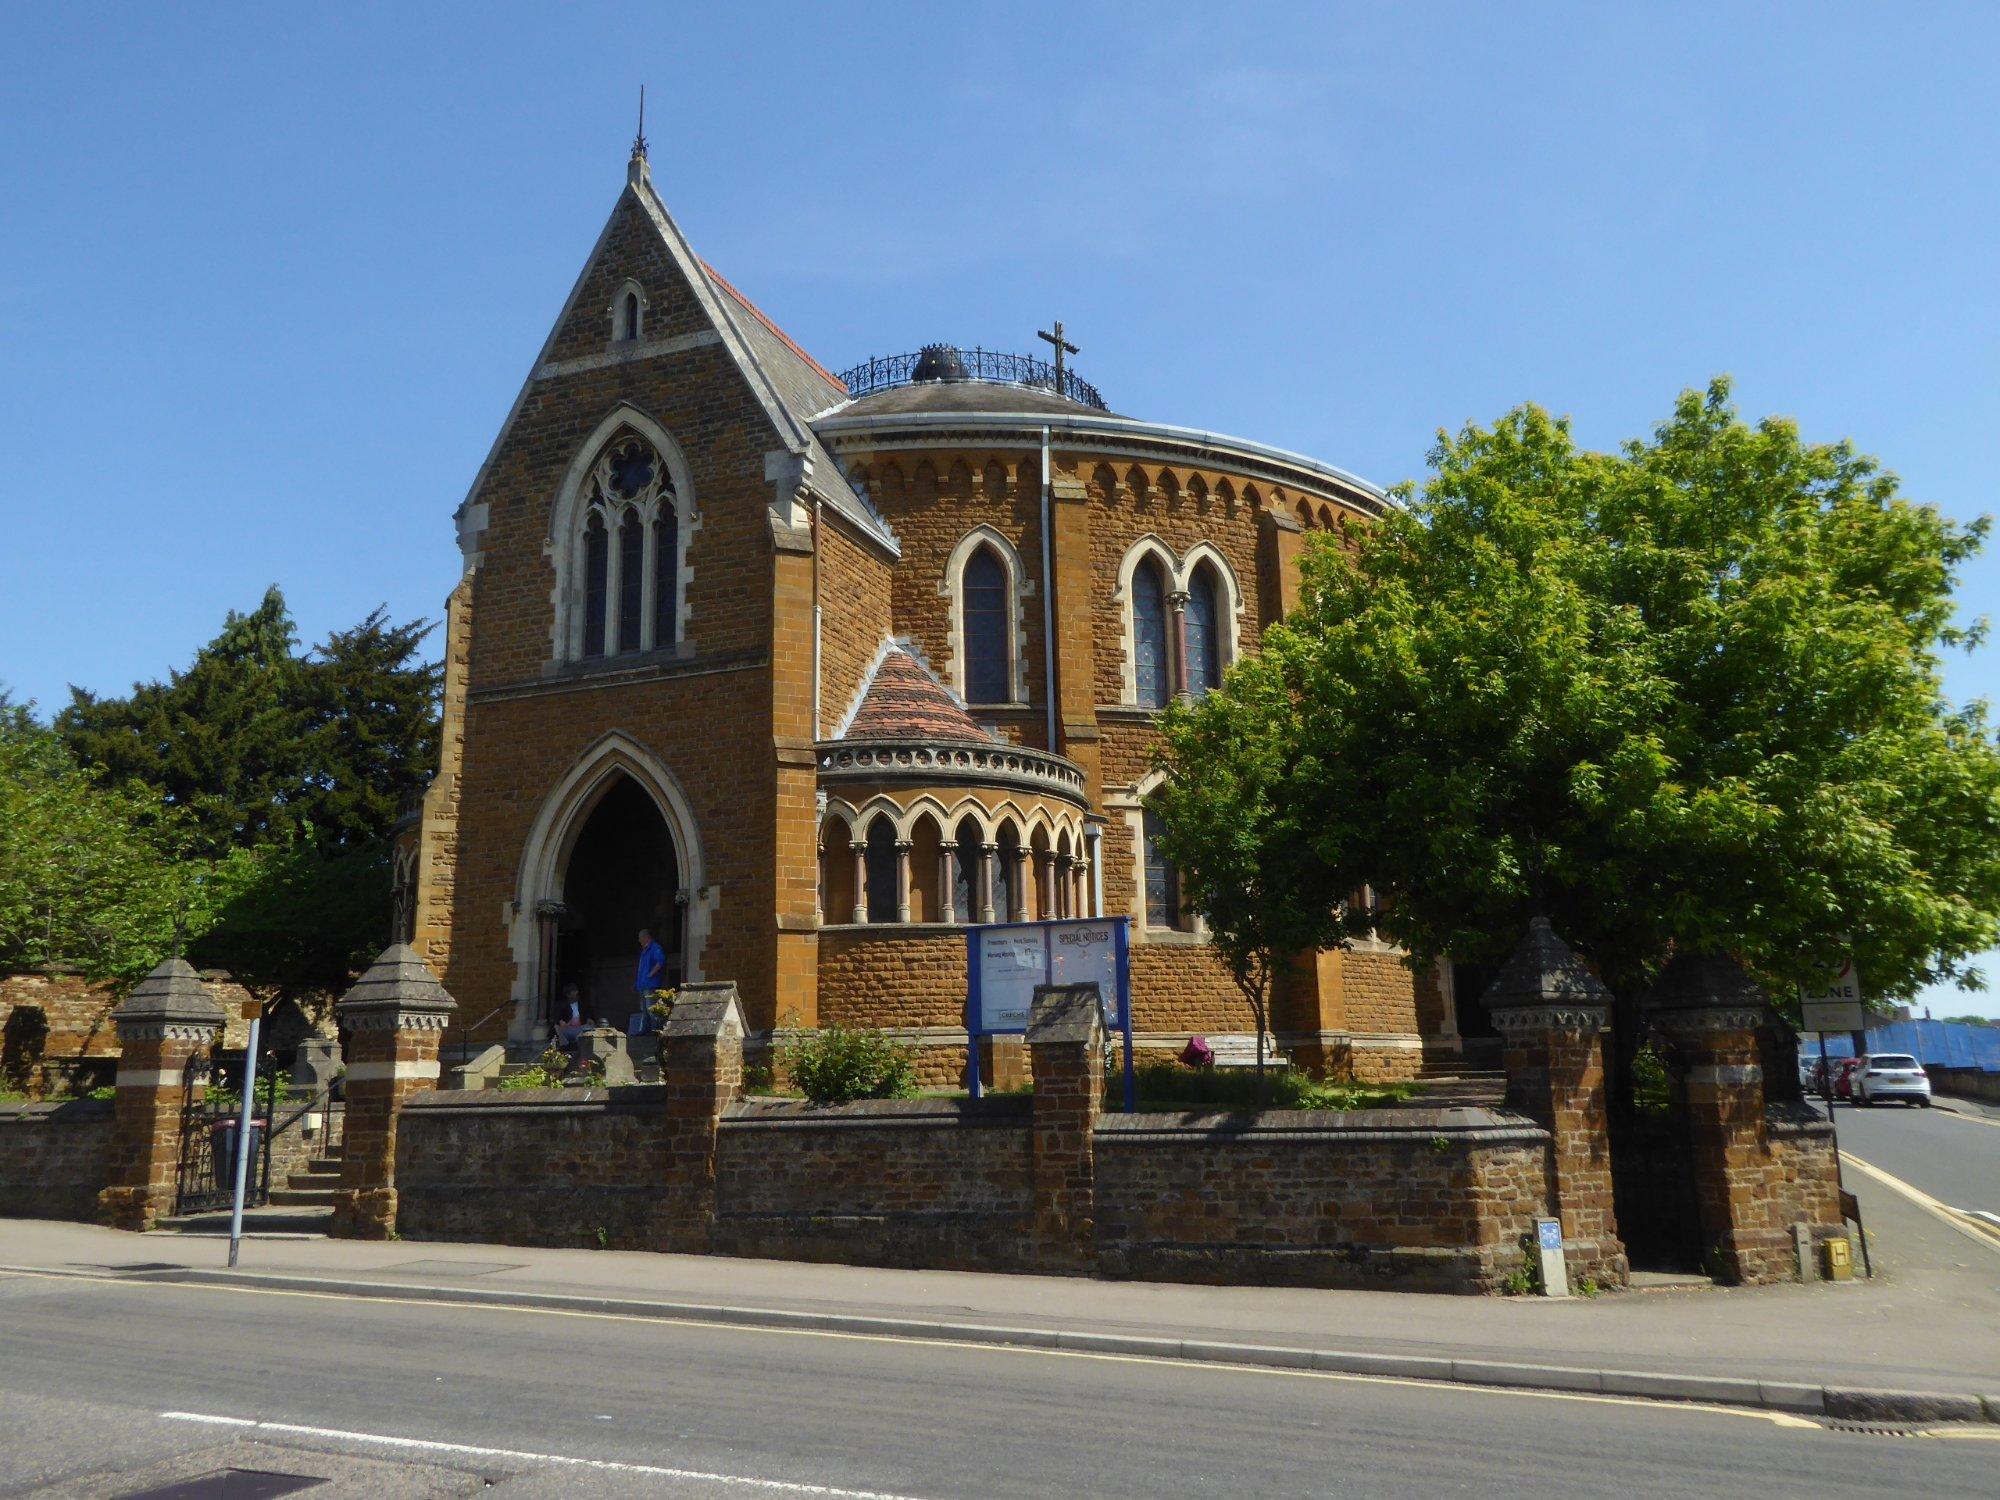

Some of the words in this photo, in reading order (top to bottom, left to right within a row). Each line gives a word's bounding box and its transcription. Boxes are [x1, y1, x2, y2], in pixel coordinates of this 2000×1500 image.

[1059, 933, 1082, 943] SPECIAL
[1083, 931, 1109, 942] NOTICES
[1835, 1246, 1846, 1264] H
